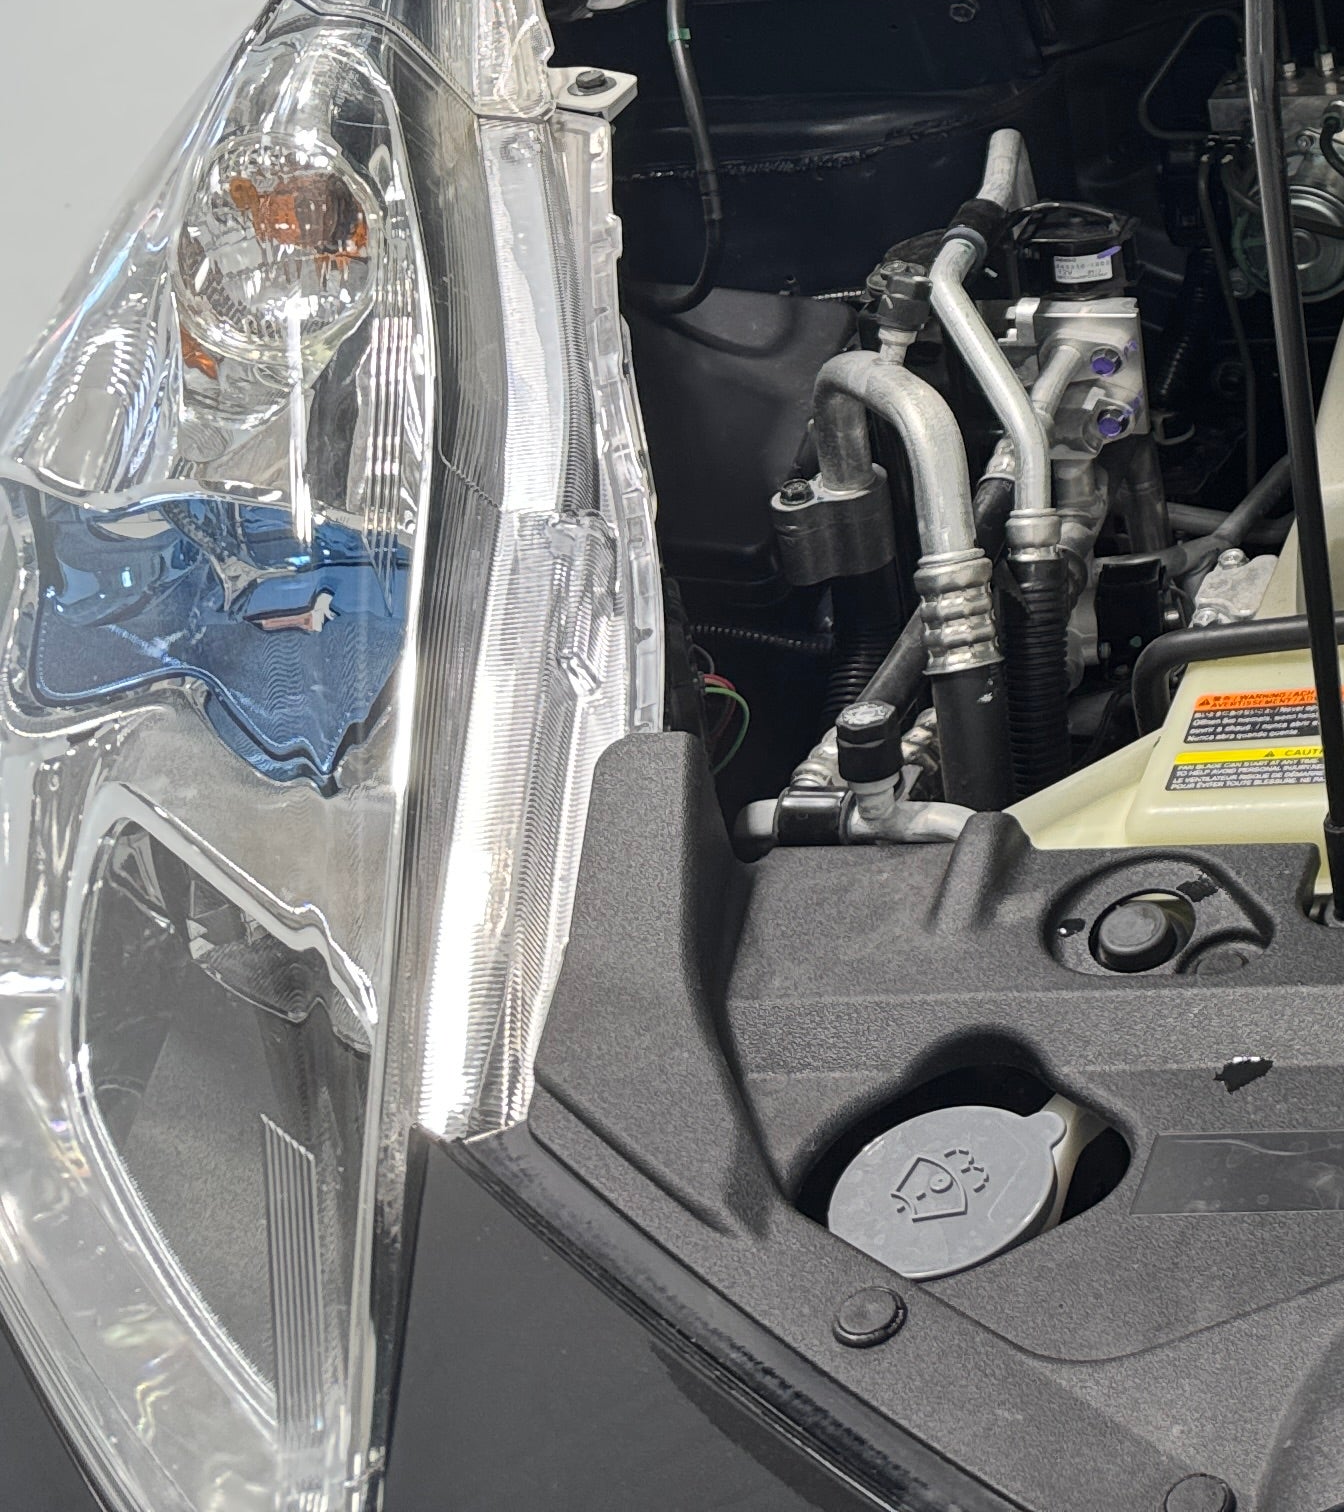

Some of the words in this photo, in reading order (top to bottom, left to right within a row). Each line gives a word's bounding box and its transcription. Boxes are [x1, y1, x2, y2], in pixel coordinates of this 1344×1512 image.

[1239, 692, 1286, 701] WARNING
[1285, 748, 1324, 757] CAUT
[1185, 774, 1238, 783] VENTILATEUR
